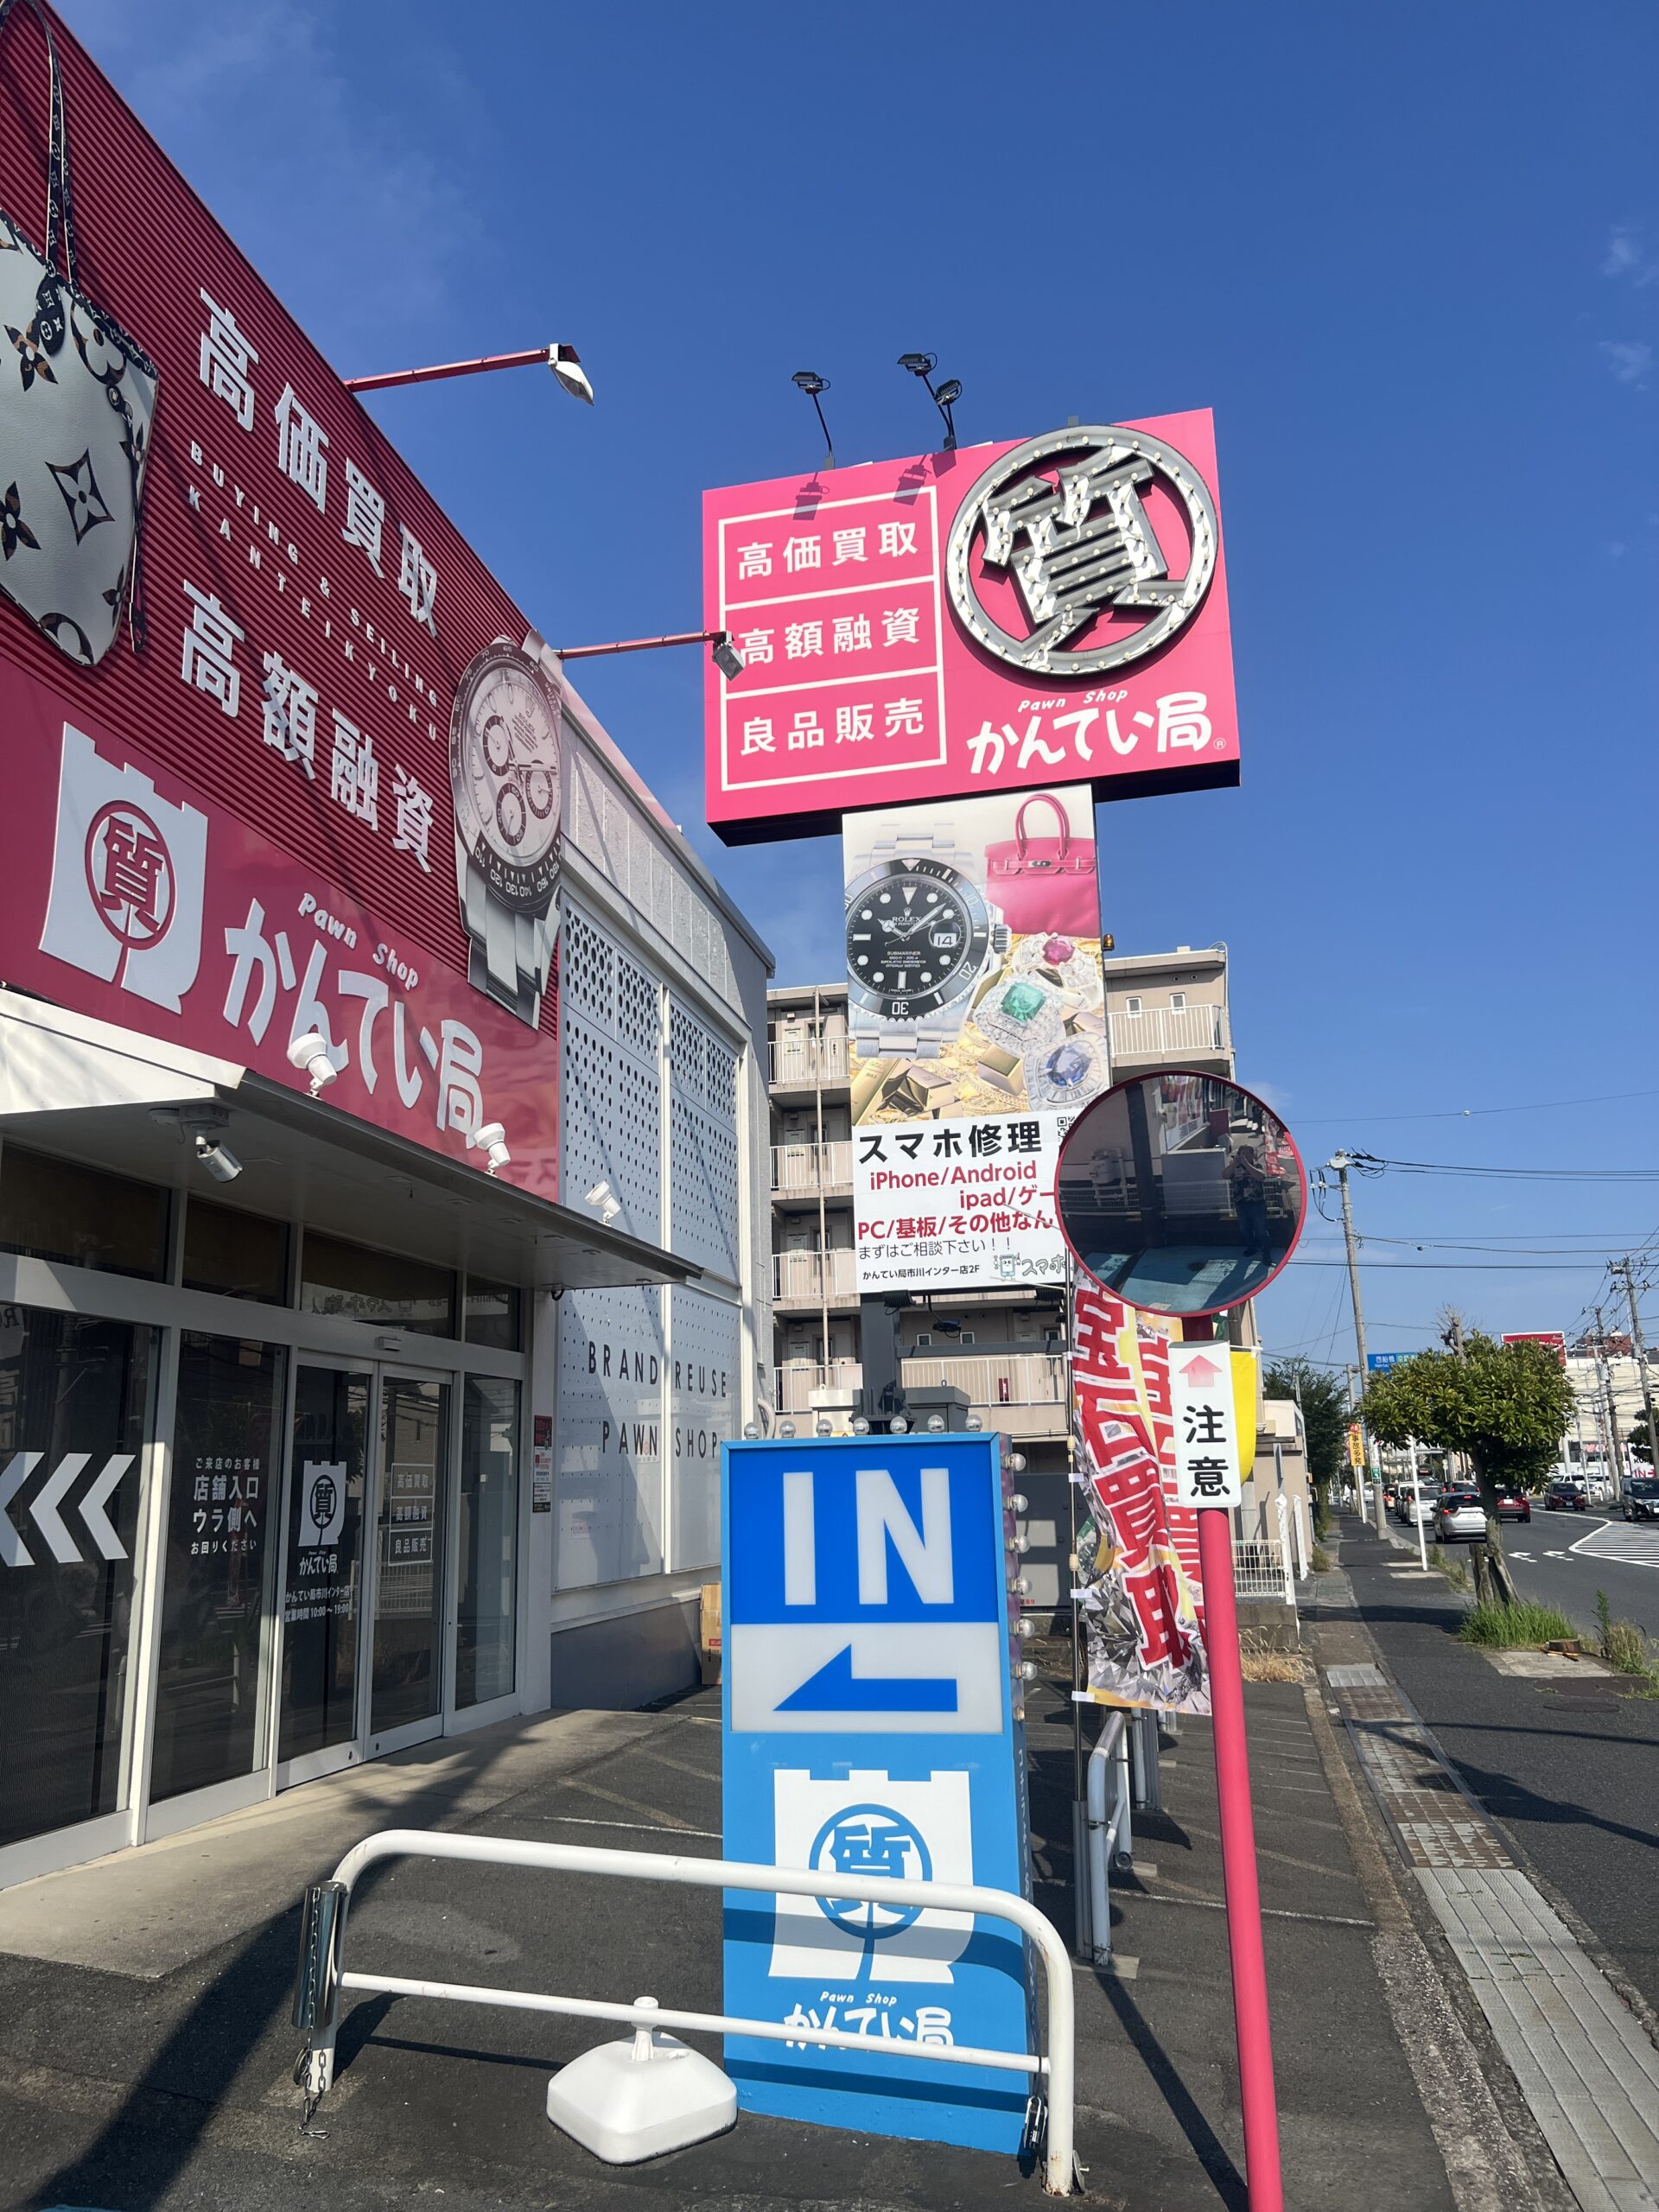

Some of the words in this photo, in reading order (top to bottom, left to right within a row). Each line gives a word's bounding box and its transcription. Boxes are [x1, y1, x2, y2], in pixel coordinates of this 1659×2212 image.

[200, 287, 438, 638] 高価買取
[191, 440, 298, 565] BUYING
[320, 576, 330, 599] &
[737, 520, 918, 581] 高価買取
[980, 443, 1187, 669] 質
[188, 485, 436, 741] KANTEIKYOKU
[739, 607, 922, 666] 高額融資
[1017, 696, 1067, 714] Pawn
[1083, 688, 1129, 704] Shop
[182, 579, 433, 873] 高額融資
[739, 696, 925, 757] 良品販売
[966, 690, 1213, 775] かんてい局
[100, 814, 164, 933] 質
[490, 868, 503, 888] 120
[298, 893, 358, 950] Pawn
[372, 942, 420, 991] Shop
[938, 936, 953, 946] 14
[223, 897, 484, 1149] かんてい局
[892, 1001, 909, 1015] 30
[859, 1121, 1042, 1164] スマホ修理
[870, 1160, 1037, 1190] iPhone/Android
[858, 1210, 1053, 1240] PC/基板/その他なん
[862, 1265, 980, 1280] かんてい局市川インター店2F
[588, 1341, 658, 1385] BRAND
[675, 1361, 727, 1397] REUSE
[602, 1421, 658, 1456] PAWN
[676, 1427, 717, 1459] SHOP
[1183, 1404, 1230, 1497] 注意
[1352, 1433, 1362, 1465] 事故多発
[195, 1457, 259, 1470] ご来店のお客様
[194, 1475, 259, 1501] 店舗入口
[397, 1474, 429, 1489] 高価買取
[193, 1507, 257, 1533] ウラ側へ
[396, 1505, 428, 1522] 高額融資
[191, 1539, 257, 1555] お回りください
[395, 1535, 427, 1554] 良品販売
[783, 1468, 955, 1606] IN
[299, 1554, 338, 1576] かんてい局
[820, 1991, 855, 2004] Pawn
[866, 1993, 898, 2006] Shop
